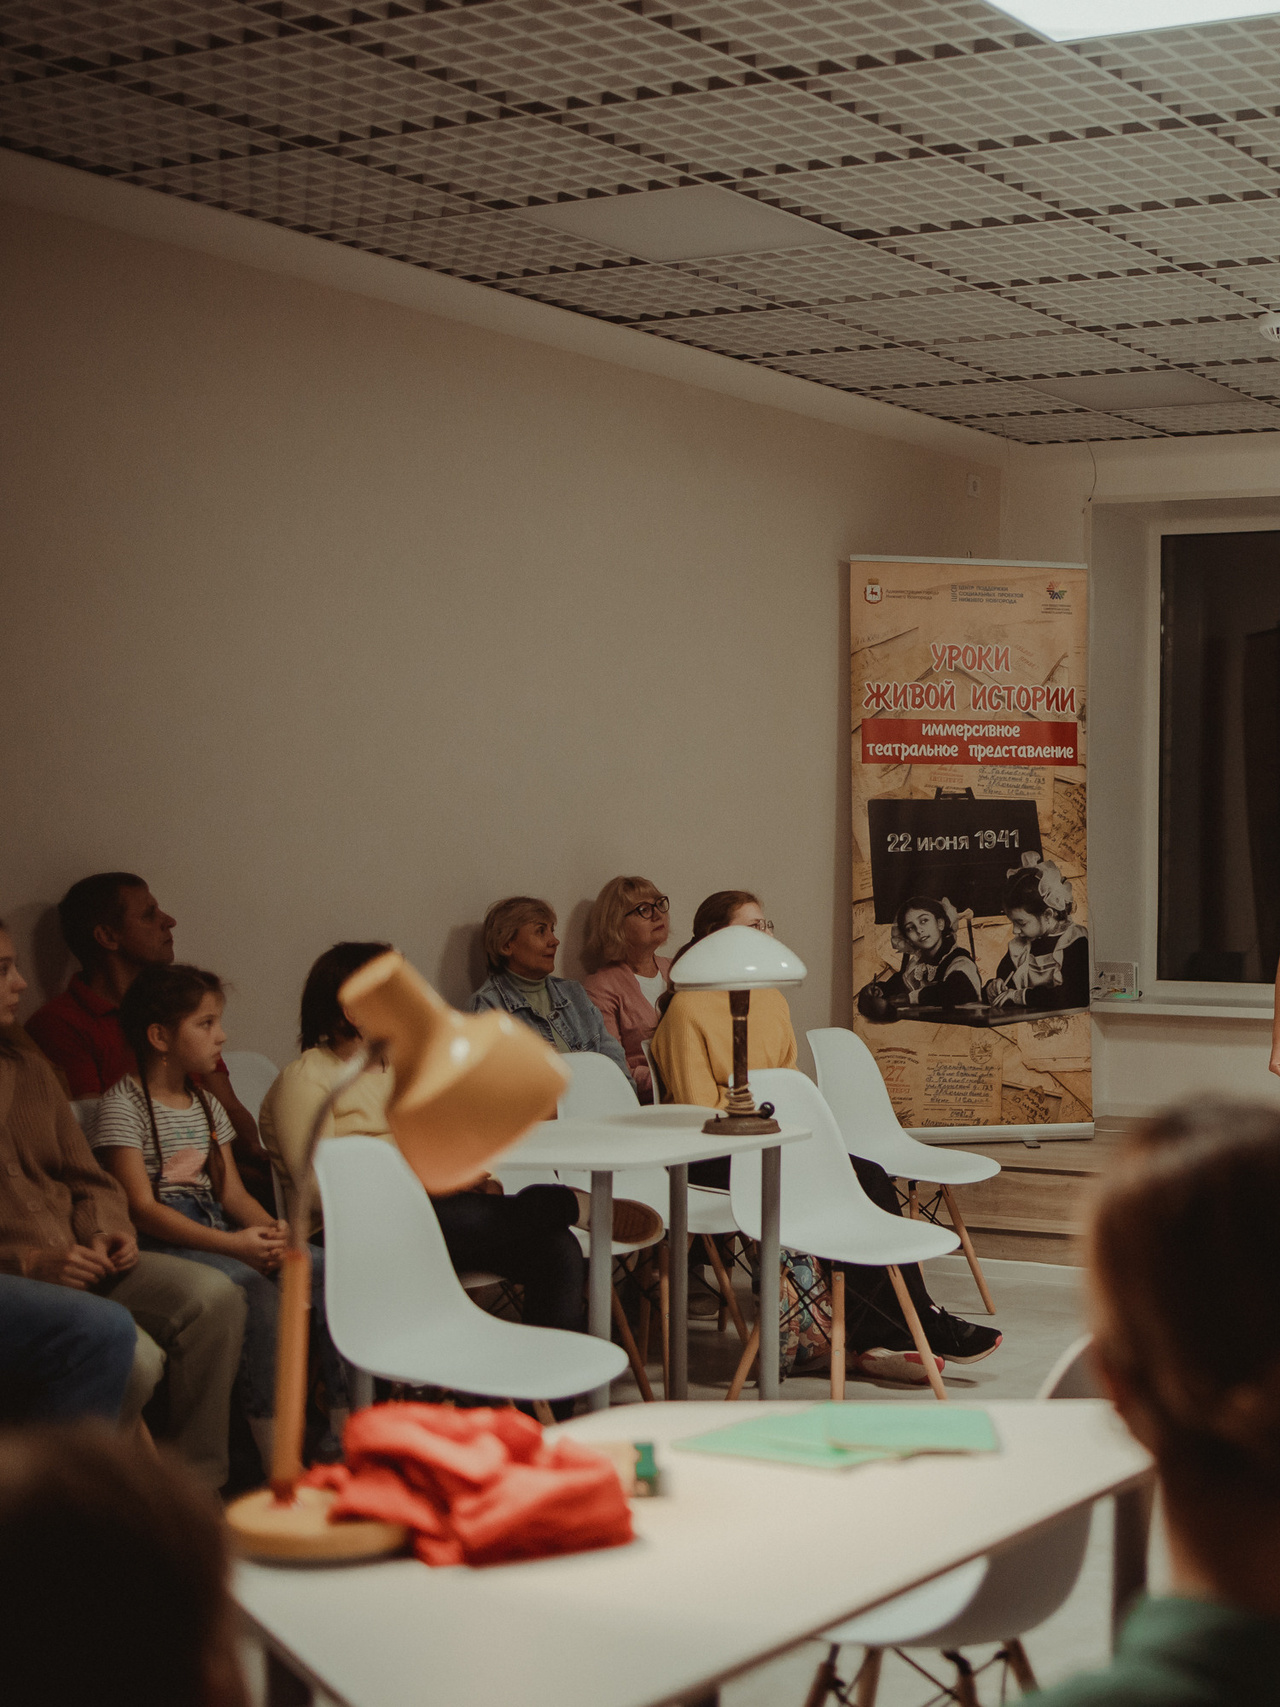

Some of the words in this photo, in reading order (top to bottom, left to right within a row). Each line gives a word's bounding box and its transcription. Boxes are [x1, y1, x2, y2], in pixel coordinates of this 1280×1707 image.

[931, 643, 1011, 673] УРОКИ
[862, 679, 957, 712] ЖИВОЙ
[970, 683, 1076, 714] ИСТОРИИ
[921, 723, 1021, 741] иммерсивное
[866, 743, 959, 761] театральное
[968, 744, 1074, 762] представление
[887, 832, 912, 853] 22
[917, 835, 970, 852] июня
[973, 829, 1020, 849] 1941
